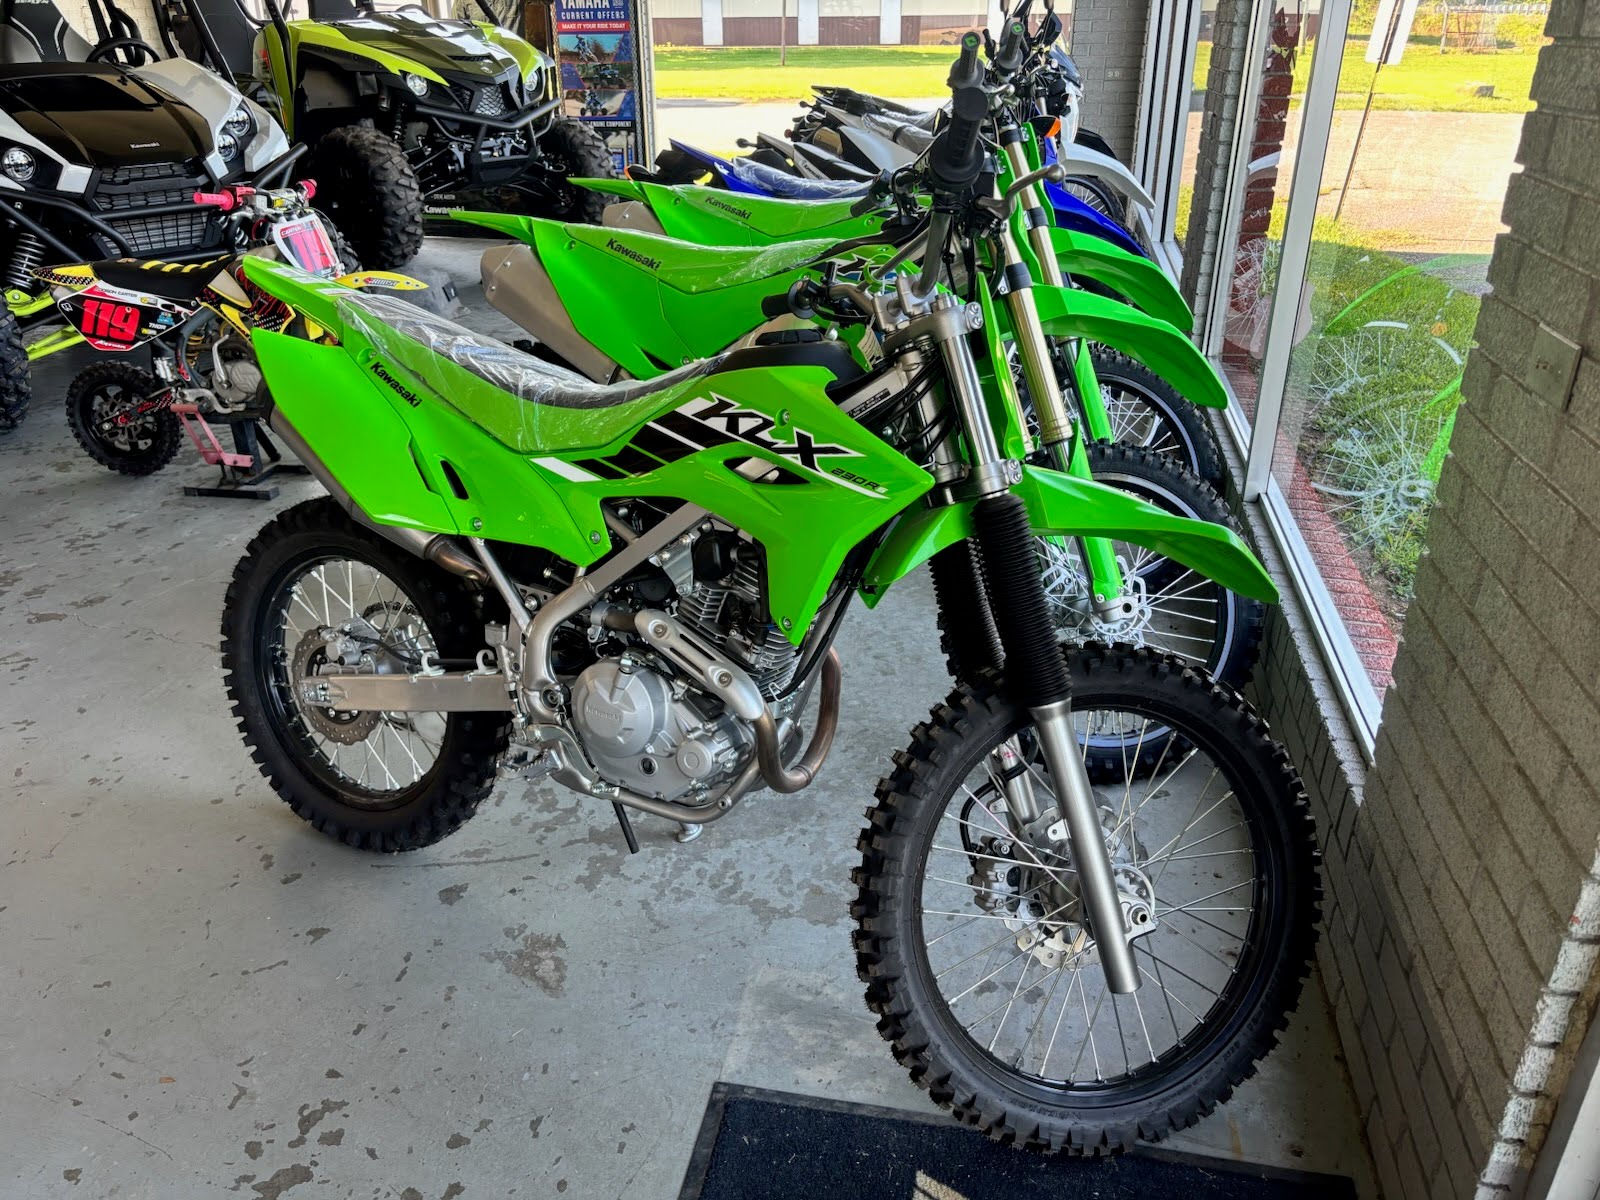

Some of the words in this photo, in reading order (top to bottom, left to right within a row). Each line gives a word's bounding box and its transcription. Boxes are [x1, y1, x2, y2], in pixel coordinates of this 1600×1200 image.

[561, 0, 610, 9] YAMAHA
[561, 11, 594, 20] CURRENT
[597, 11, 625, 19] OFFERS
[705, 195, 752, 220] Kawasaki
[606, 238, 662, 271] Kawasaki
[81, 299, 140, 342] 119
[148, 322, 167, 330] THOR
[370, 361, 423, 408] Kawasaki
